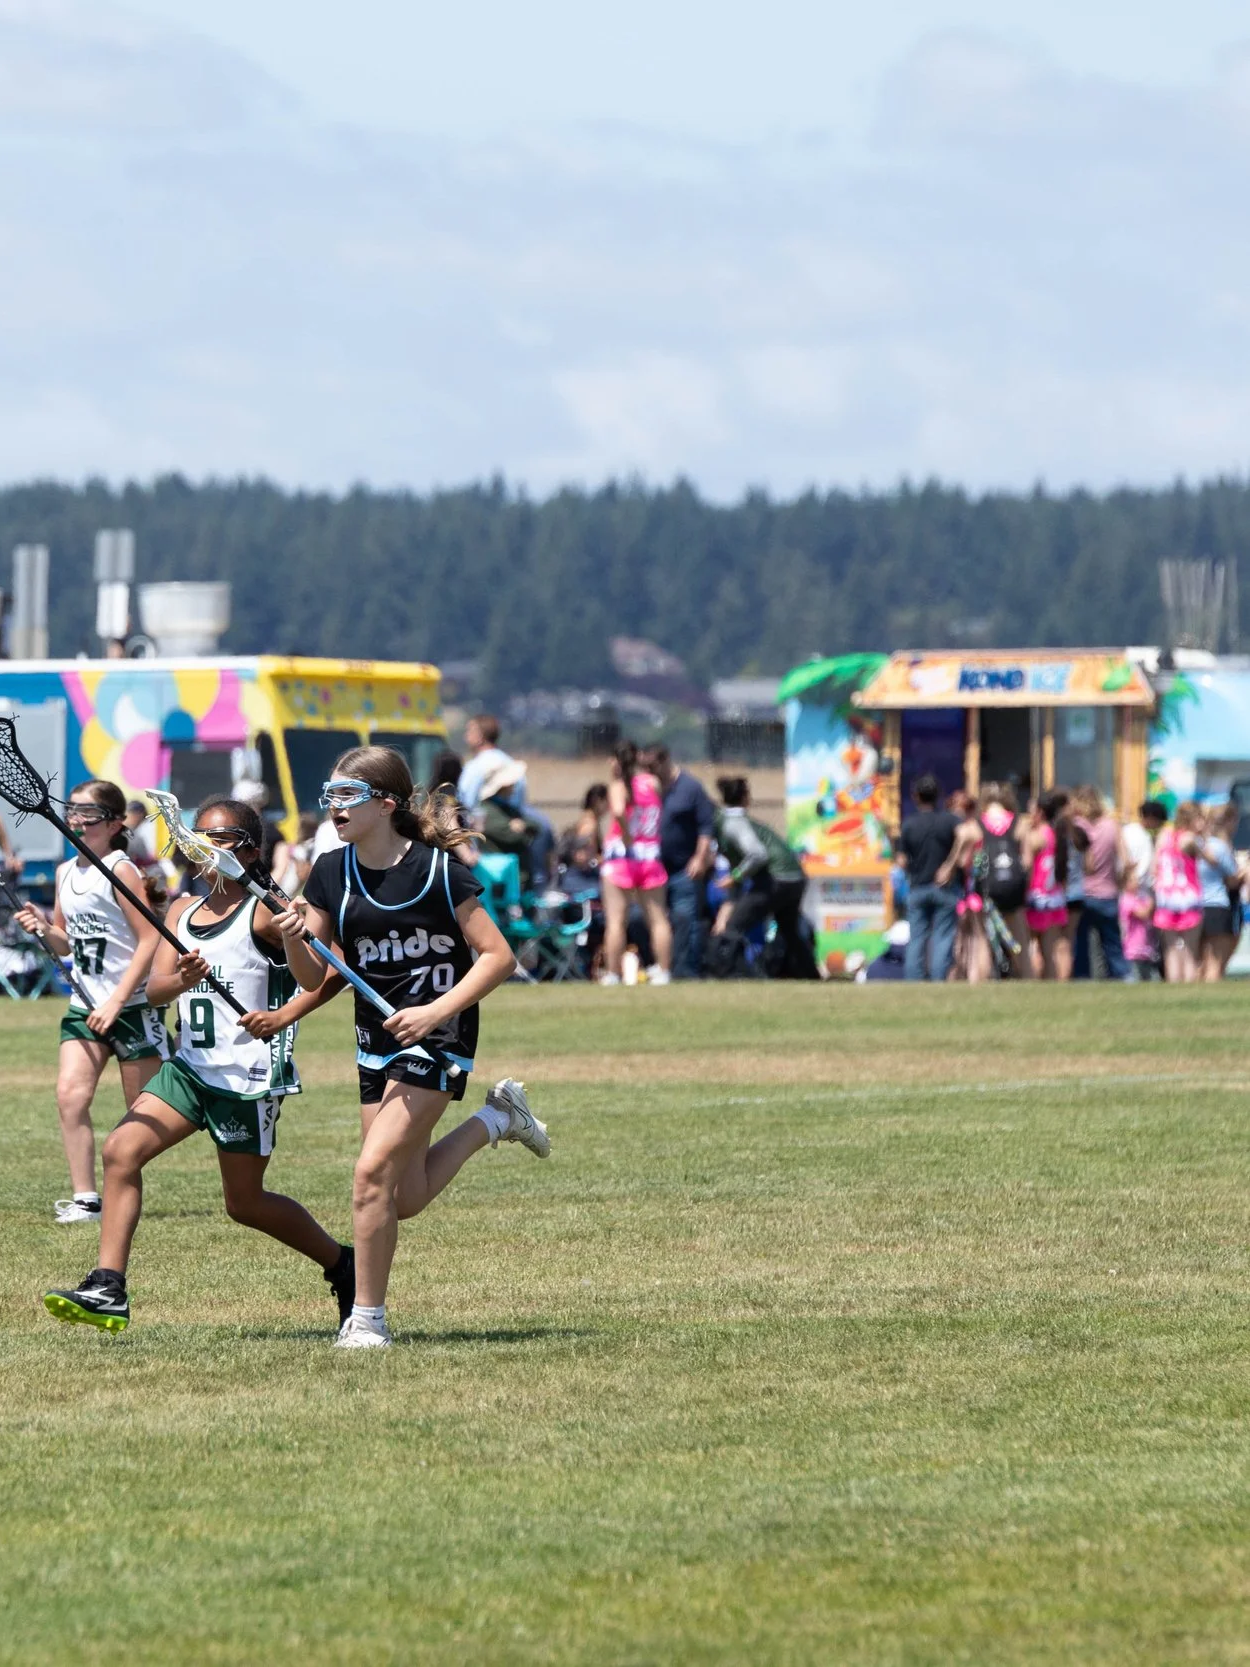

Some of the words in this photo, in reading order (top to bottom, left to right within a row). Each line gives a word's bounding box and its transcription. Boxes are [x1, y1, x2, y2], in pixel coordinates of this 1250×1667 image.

[73, 937, 108, 976] 47
[356, 927, 456, 970] pride
[408, 962, 455, 995] 70
[189, 997, 216, 1049] 9
